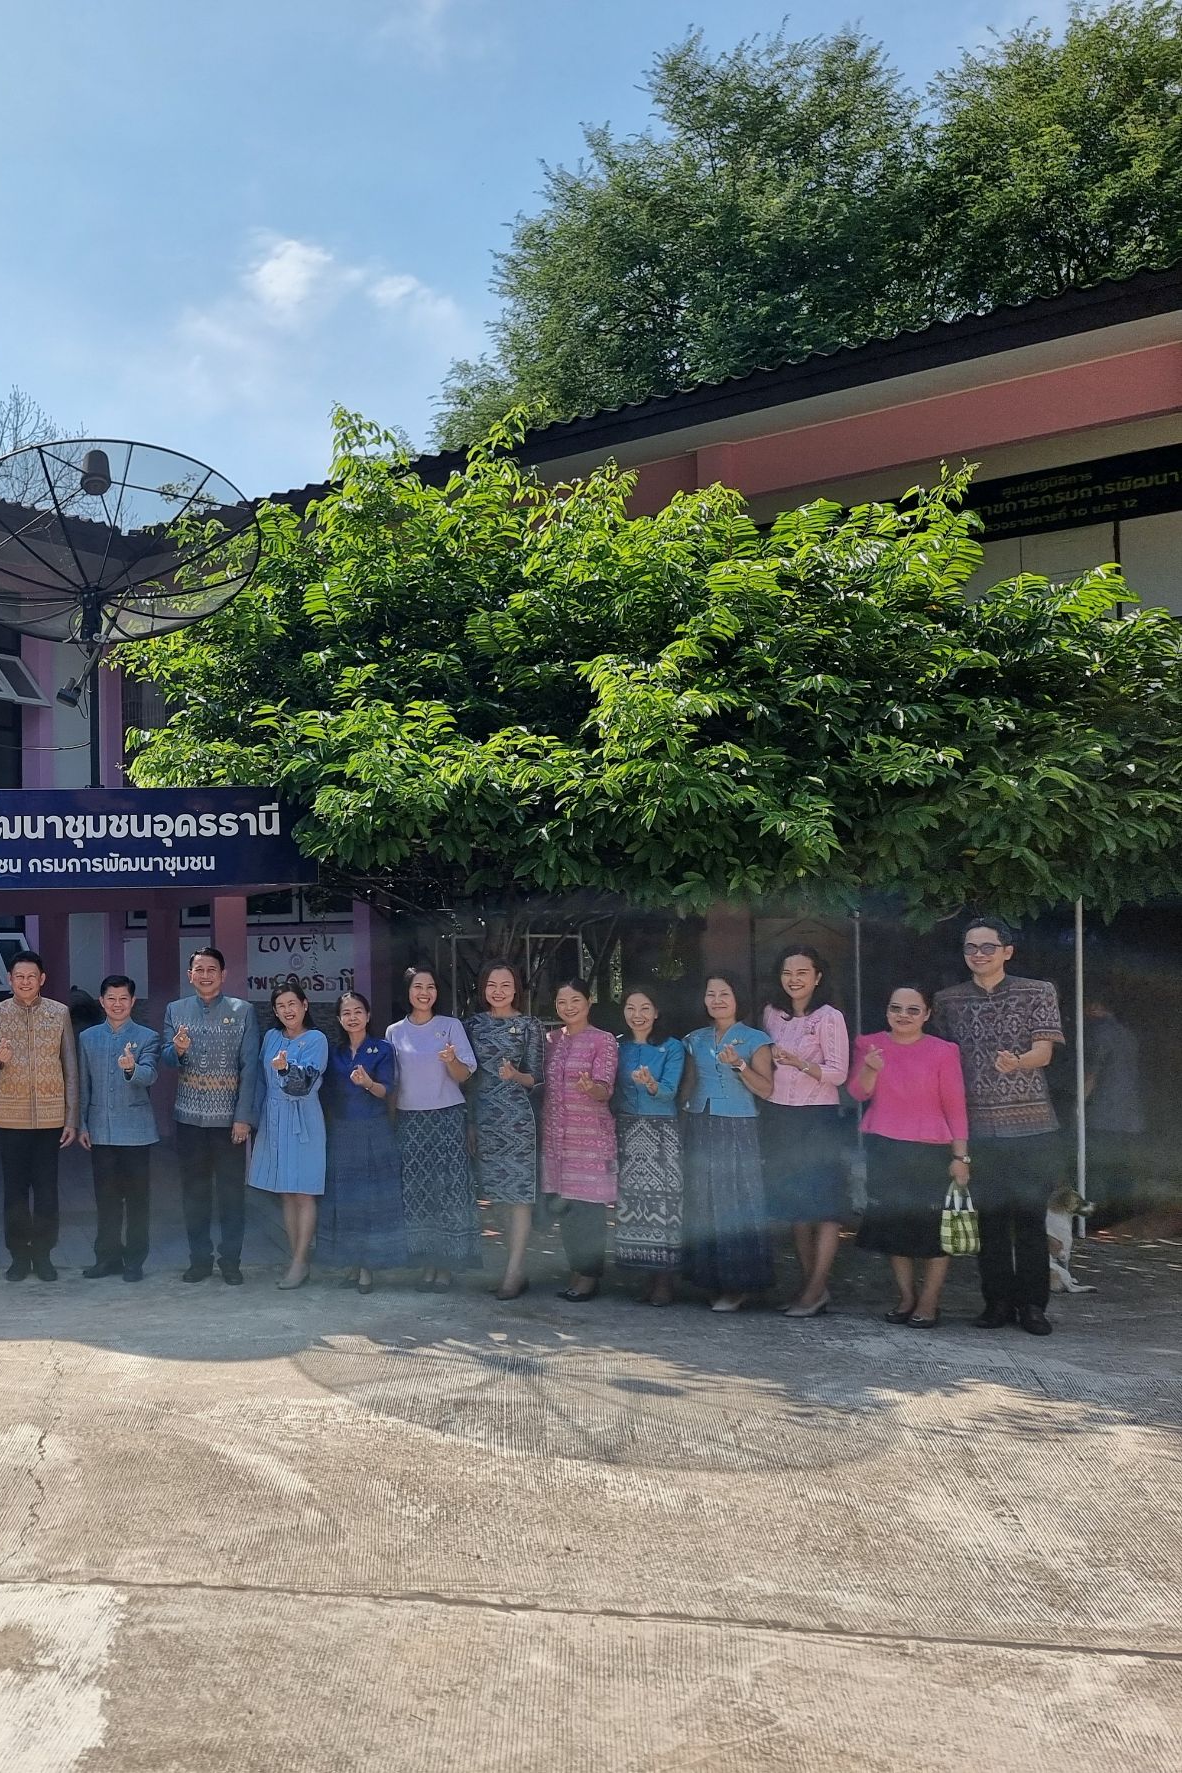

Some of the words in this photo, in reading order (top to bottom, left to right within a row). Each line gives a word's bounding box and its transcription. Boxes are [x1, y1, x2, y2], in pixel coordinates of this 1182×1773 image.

[974, 472, 1182, 520] ราชการกรมการพัฒนา
[28, 852, 216, 877] กรมการพัฒนาชุมชน
[258, 936, 313, 953] LOVE
